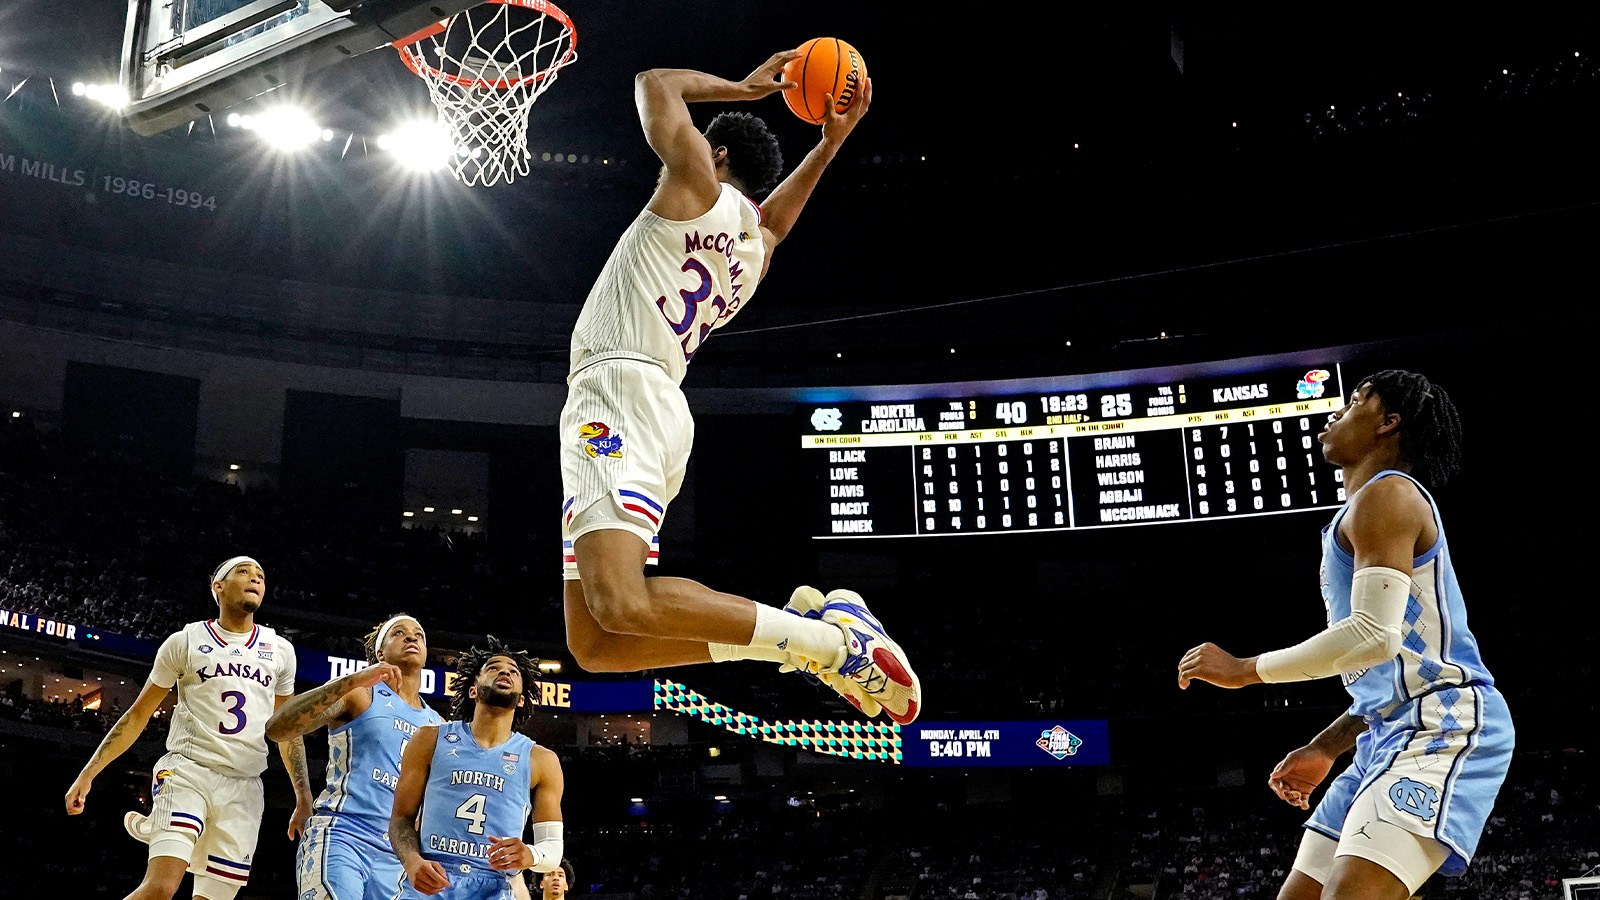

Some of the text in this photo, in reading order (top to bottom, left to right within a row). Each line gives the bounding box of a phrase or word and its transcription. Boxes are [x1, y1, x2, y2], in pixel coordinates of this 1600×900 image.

[836, 50, 859, 106] Wilson
[21, 158, 85, 186] MILLS
[104, 175, 217, 212] 1986-1994
[1213, 384, 1268, 402] KANSAS
[871, 404, 915, 418] NORTH
[996, 402, 1027, 424] 40
[1101, 394, 1132, 417] 25
[862, 418, 926, 432] CAROLINA
[1064, 414, 1082, 423] HALF
[599, 440, 612, 449] KU
[1094, 418, 1309, 450] BRAUN 2 7 1 0 0
[830, 441, 1058, 462] BLACK 2 0 1 0 0 2
[1096, 436, 1311, 468] HARRIS 0 0 1 1 0
[830, 459, 1059, 480] LOVE 4 1 1 0 1 2
[1097, 454, 1312, 485] WILSON 4 1 0 0 1
[831, 476, 1060, 497] DAVIS 11 6 1 0 0 0
[1198, 483, 1207, 496] 8
[1225, 481, 1234, 493] 3
[1252, 478, 1261, 491] 0
[1281, 475, 1287, 488] 1
[1309, 472, 1315, 485] 1
[831, 502, 869, 515] BACOT
[948, 499, 961, 511] 10
[978, 498, 983, 510] 1
[1004, 497, 1009, 509] 1
[1027, 495, 1036, 508] 0
[1055, 494, 1061, 506] 1
[1100, 504, 1180, 522] MCCORMACK
[1227, 499, 1236, 512] 3
[1254, 496, 1263, 509] 0
[1281, 494, 1290, 507] 0
[1311, 491, 1317, 503] 1
[832, 520, 873, 533] MANEK
[952, 517, 961, 529] 4
[977, 516, 985, 528] 0
[1003, 515, 1011, 527] 0
[36, 617, 77, 640] FOUR
[195, 662, 273, 688] KANSAS
[218, 690, 248, 735] 3
[920, 730, 1000, 741] MONDAY, APRIL 4TH
[930, 741, 991, 757] 9:40 PM
[450, 771, 505, 792] NORTH
[455, 793, 487, 835] 4
